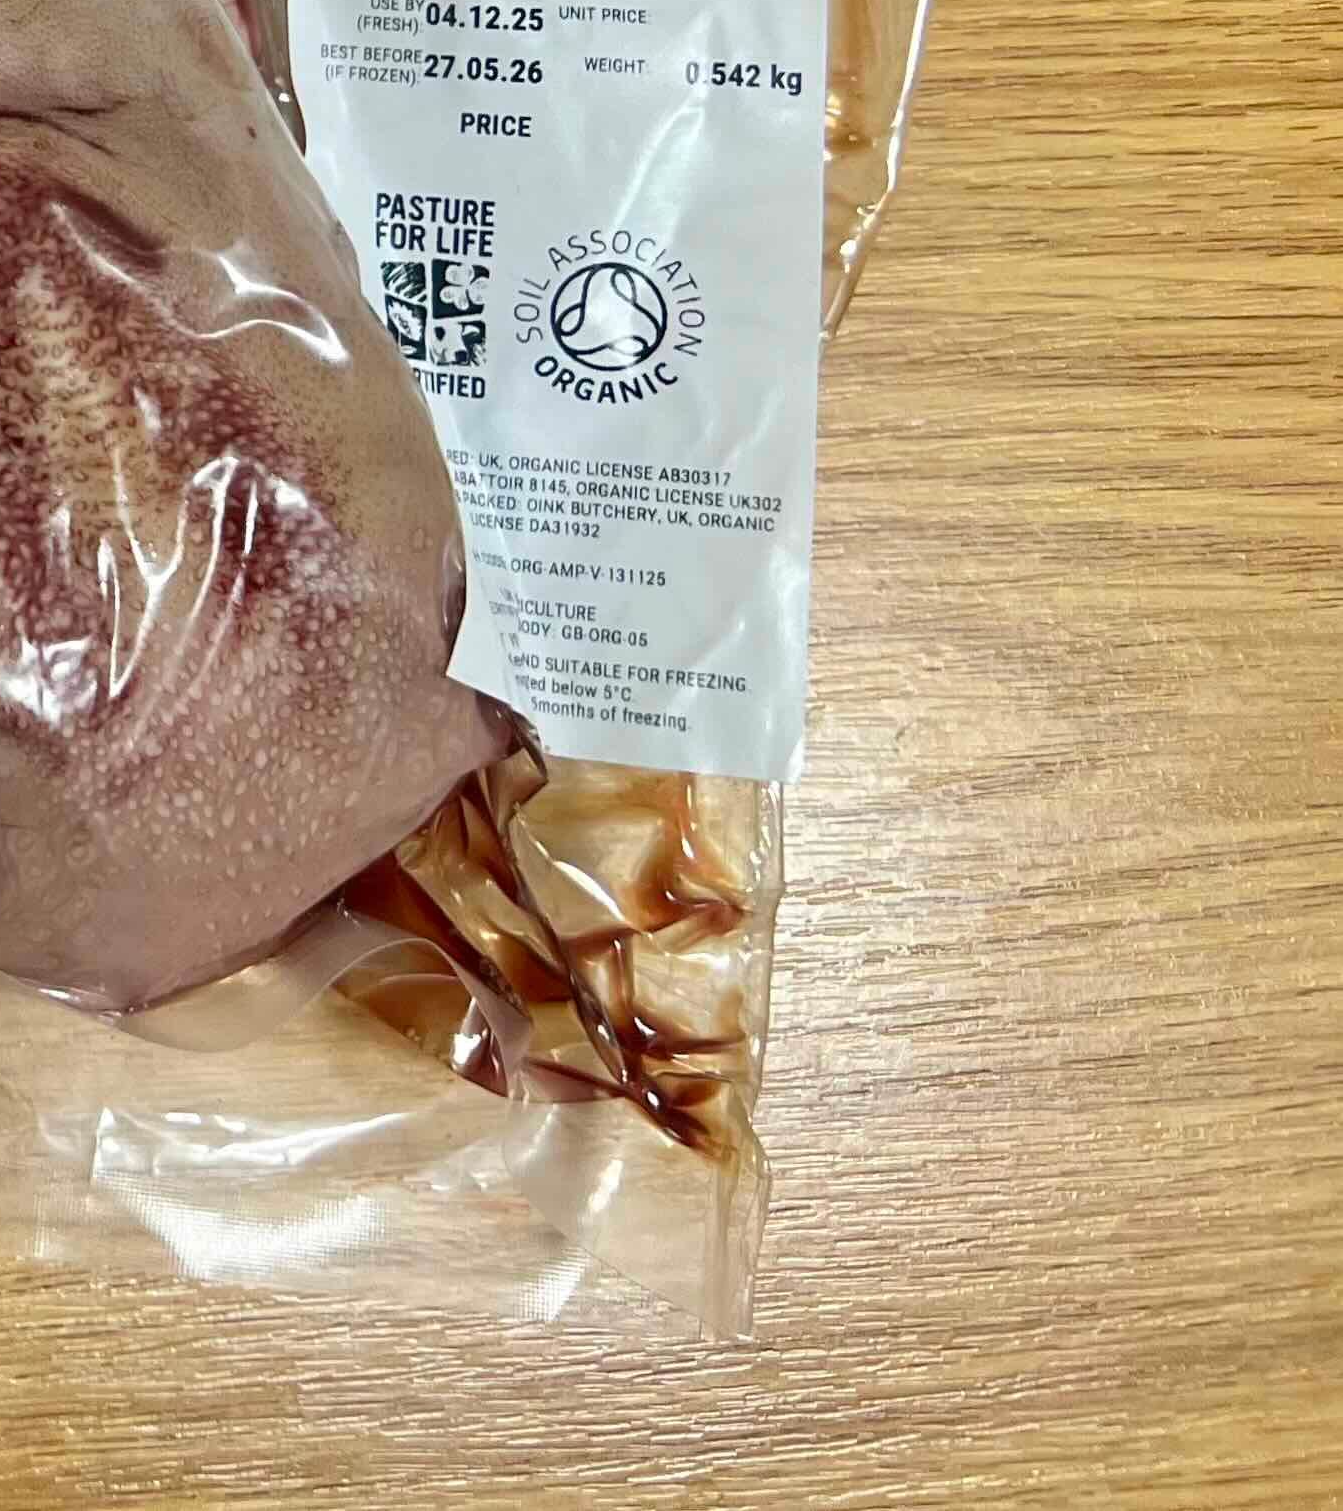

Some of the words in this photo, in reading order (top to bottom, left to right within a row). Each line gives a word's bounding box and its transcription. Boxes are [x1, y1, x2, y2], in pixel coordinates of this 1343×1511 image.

[425, 2, 544, 32] 04.12.25
[558, 4, 596, 22] UNIT
[320, 43, 358, 59] BEST
[363, 45, 423, 64] BEFORE
[325, 64, 347, 82] (IF
[423, 54, 543, 84] 27.05.26
[685, 61, 761, 88] 0.542
[770, 64, 802, 97] kg
[460, 112, 532, 138] PRICE
[376, 192, 496, 228] PASTURE
[376, 221, 426, 252] FOR
[436, 227, 494, 258] LIFE
[513, 276, 551, 344] SOIL
[547, 229, 706, 357] ASSOCIATION
[533, 355, 679, 404] ORGANIC
[508, 456, 581, 475] ORGANIC
[586, 461, 654, 481] LICENSE
[658, 467, 731, 487] AB30317
[576, 481, 650, 502] ORGANIC
[656, 488, 724, 508] LICENSE
[729, 494, 782, 513] UK302
[527, 498, 564, 514] OINK
[698, 512, 775, 532] ORGANIC
[529, 518, 600, 539] DA31932
[520, 599, 597, 622] ICULTURE
[545, 656, 622, 679] SUITABLE
[627, 665, 660, 684] FOR
[551, 677, 597, 698] below
[600, 706, 617, 722] of
